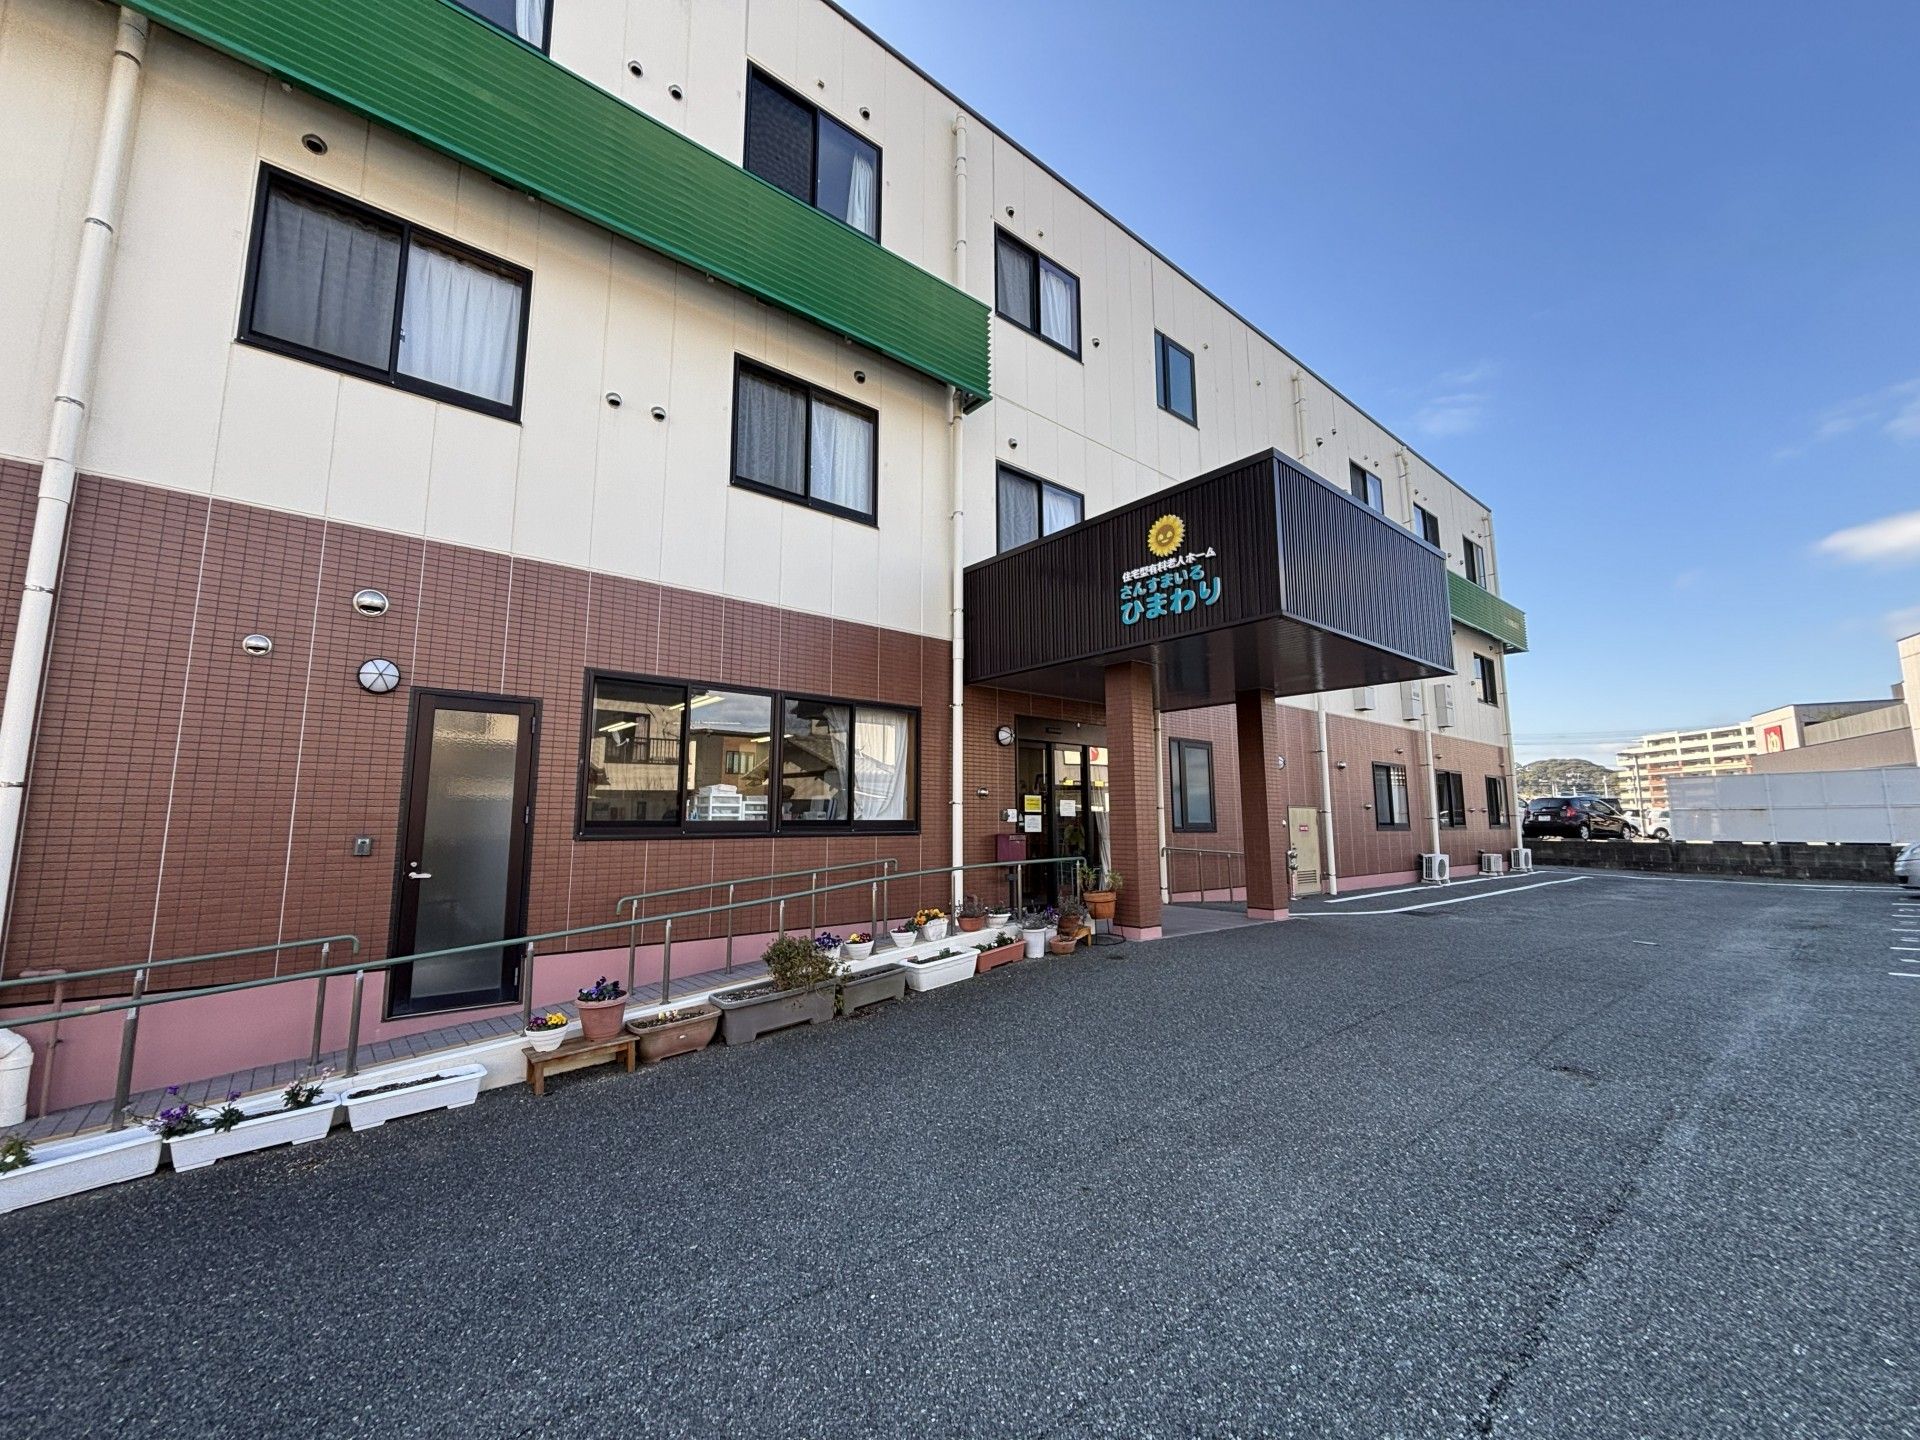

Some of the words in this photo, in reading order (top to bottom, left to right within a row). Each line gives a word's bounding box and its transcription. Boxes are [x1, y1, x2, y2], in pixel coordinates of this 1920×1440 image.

[1122, 547, 1217, 583] 住宅型有料老人ホーム
[1120, 577, 1221, 625] ひまわり
